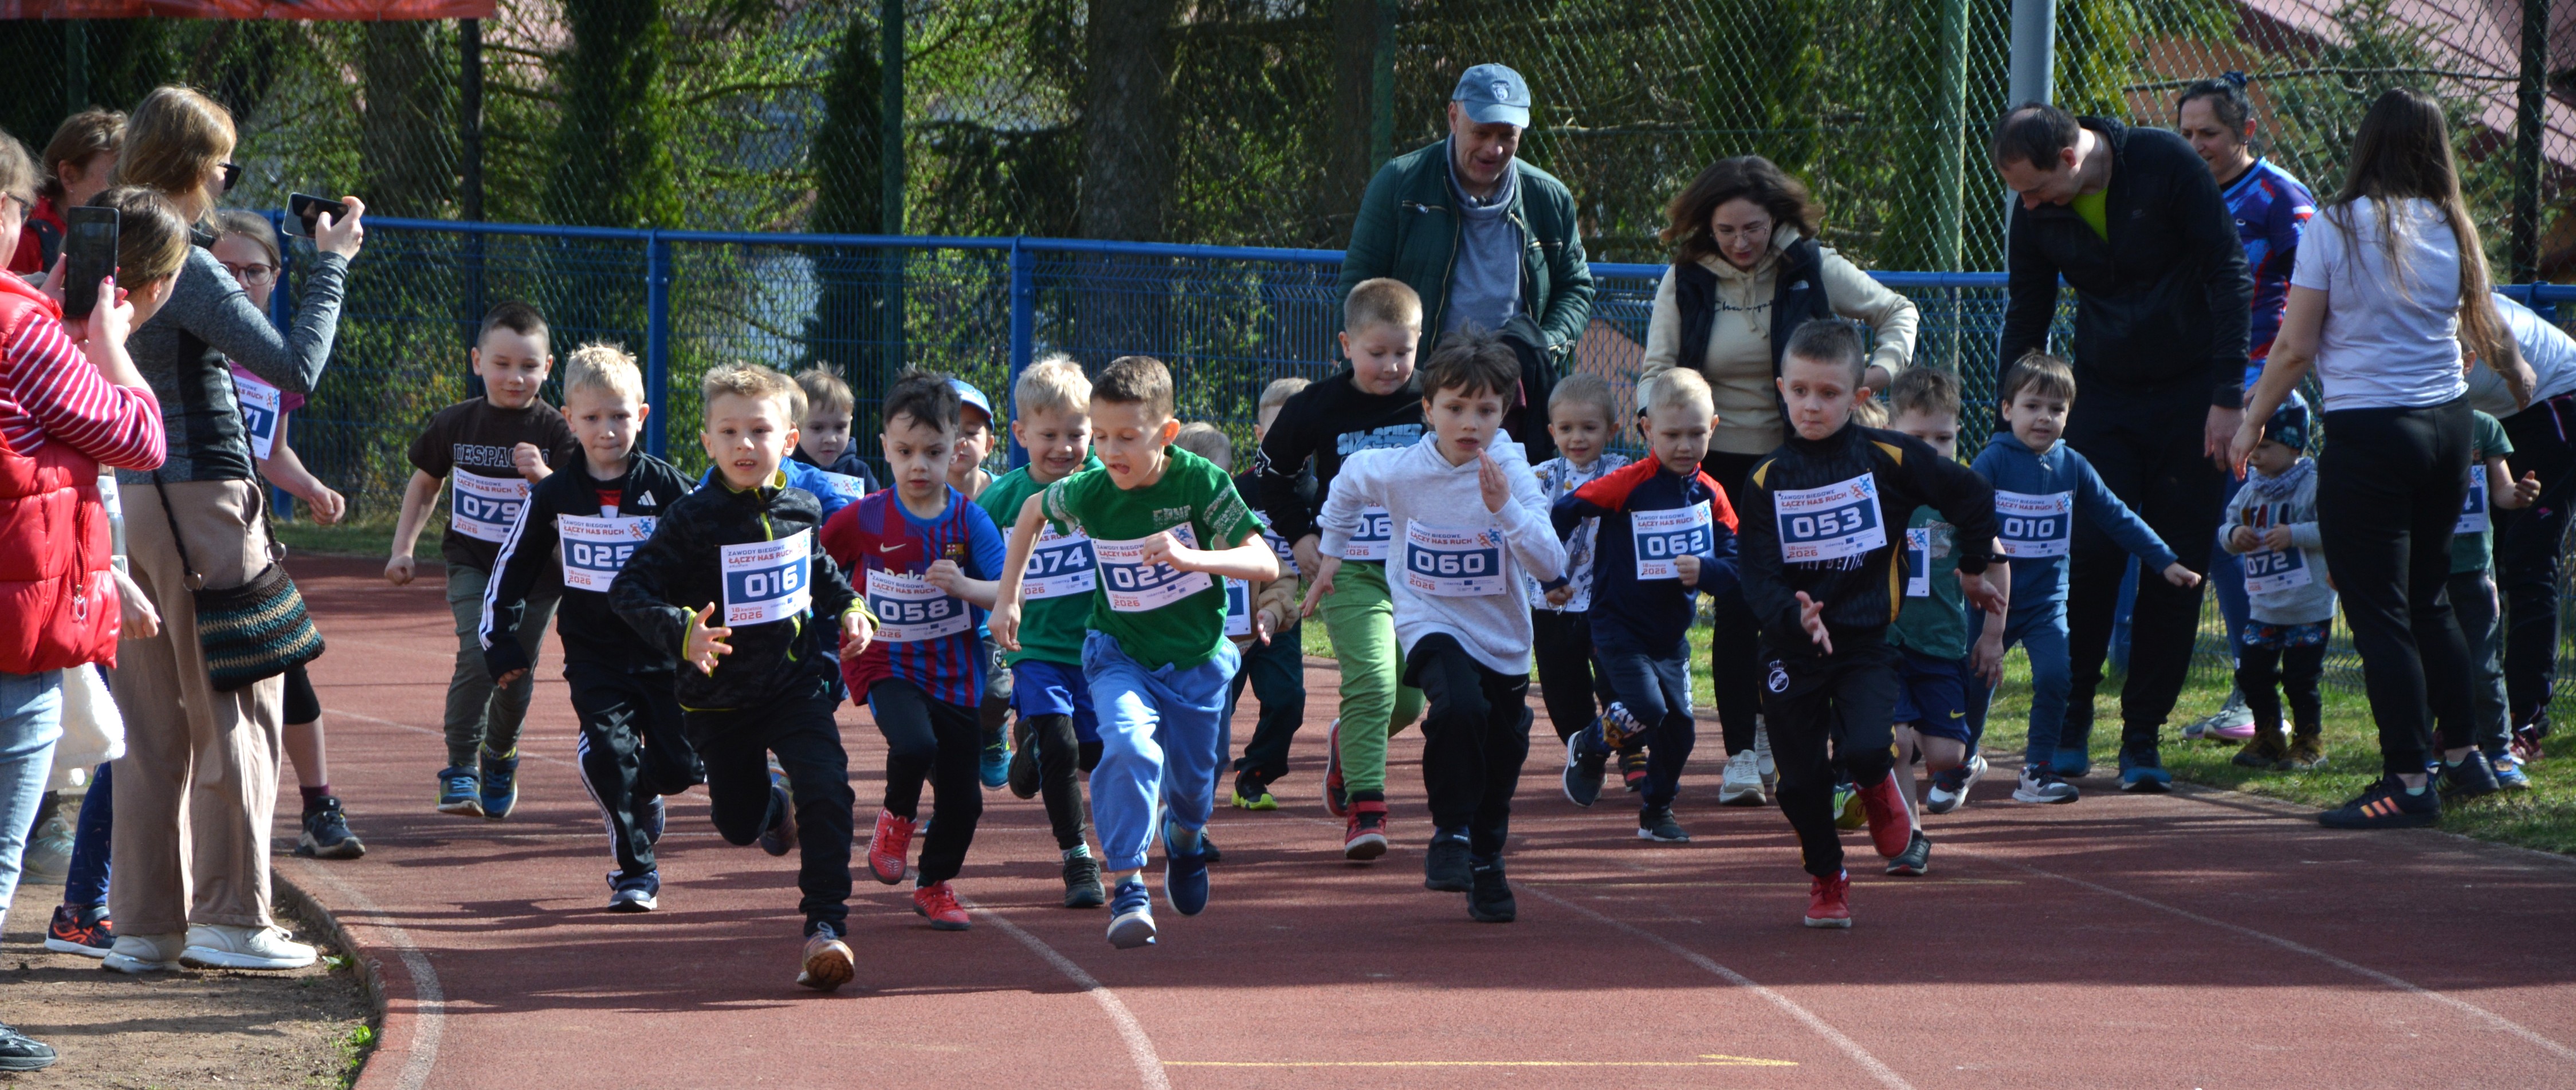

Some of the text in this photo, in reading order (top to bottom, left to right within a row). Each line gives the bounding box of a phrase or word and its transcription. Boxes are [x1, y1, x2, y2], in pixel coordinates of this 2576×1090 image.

[238, 388, 264, 400] AS RUCH
[243, 406, 262, 431] 71
[457, 478, 474, 487] ŁĄCZY
[476, 484, 490, 492] NAS
[1781, 499, 1805, 508] ŁĄCZY
[1825, 492, 1847, 502] RUCH
[1806, 489, 1835, 499] BIEGOWE
[463, 495, 521, 522] 079
[1354, 517, 1393, 537] 06
[1676, 517, 1694, 525] RUCH
[1792, 506, 1862, 538] 053
[2004, 517, 2055, 538] 010
[456, 522, 478, 534] 2026
[564, 525, 584, 534] ŁĄCZY
[1411, 525, 1431, 536] ZAWODY
[1411, 532, 1430, 543] ŁĄCZY
[1647, 530, 1703, 556] 062
[574, 543, 634, 568] 025
[757, 545, 785, 554] BIEGOWE
[1099, 550, 1120, 558] ŁĄCZY
[1789, 549, 1818, 558] 2026
[728, 556, 756, 564] ŁĄCZY
[776, 549, 793, 558] RUCH
[1026, 546, 1087, 574] 074
[1415, 550, 1485, 574] 060
[2247, 551, 2290, 575] 072
[569, 575, 591, 585] 2026
[745, 564, 798, 597] 016
[873, 576, 894, 585] ZAWODY
[1113, 560, 1180, 588] 023
[873, 582, 894, 591] ŁĄCZY
[1024, 587, 1045, 595] 026
[1409, 578, 1435, 591] 2026
[1114, 599, 1140, 607] 2026
[732, 611, 763, 621] 2026
[879, 599, 950, 621] 058
